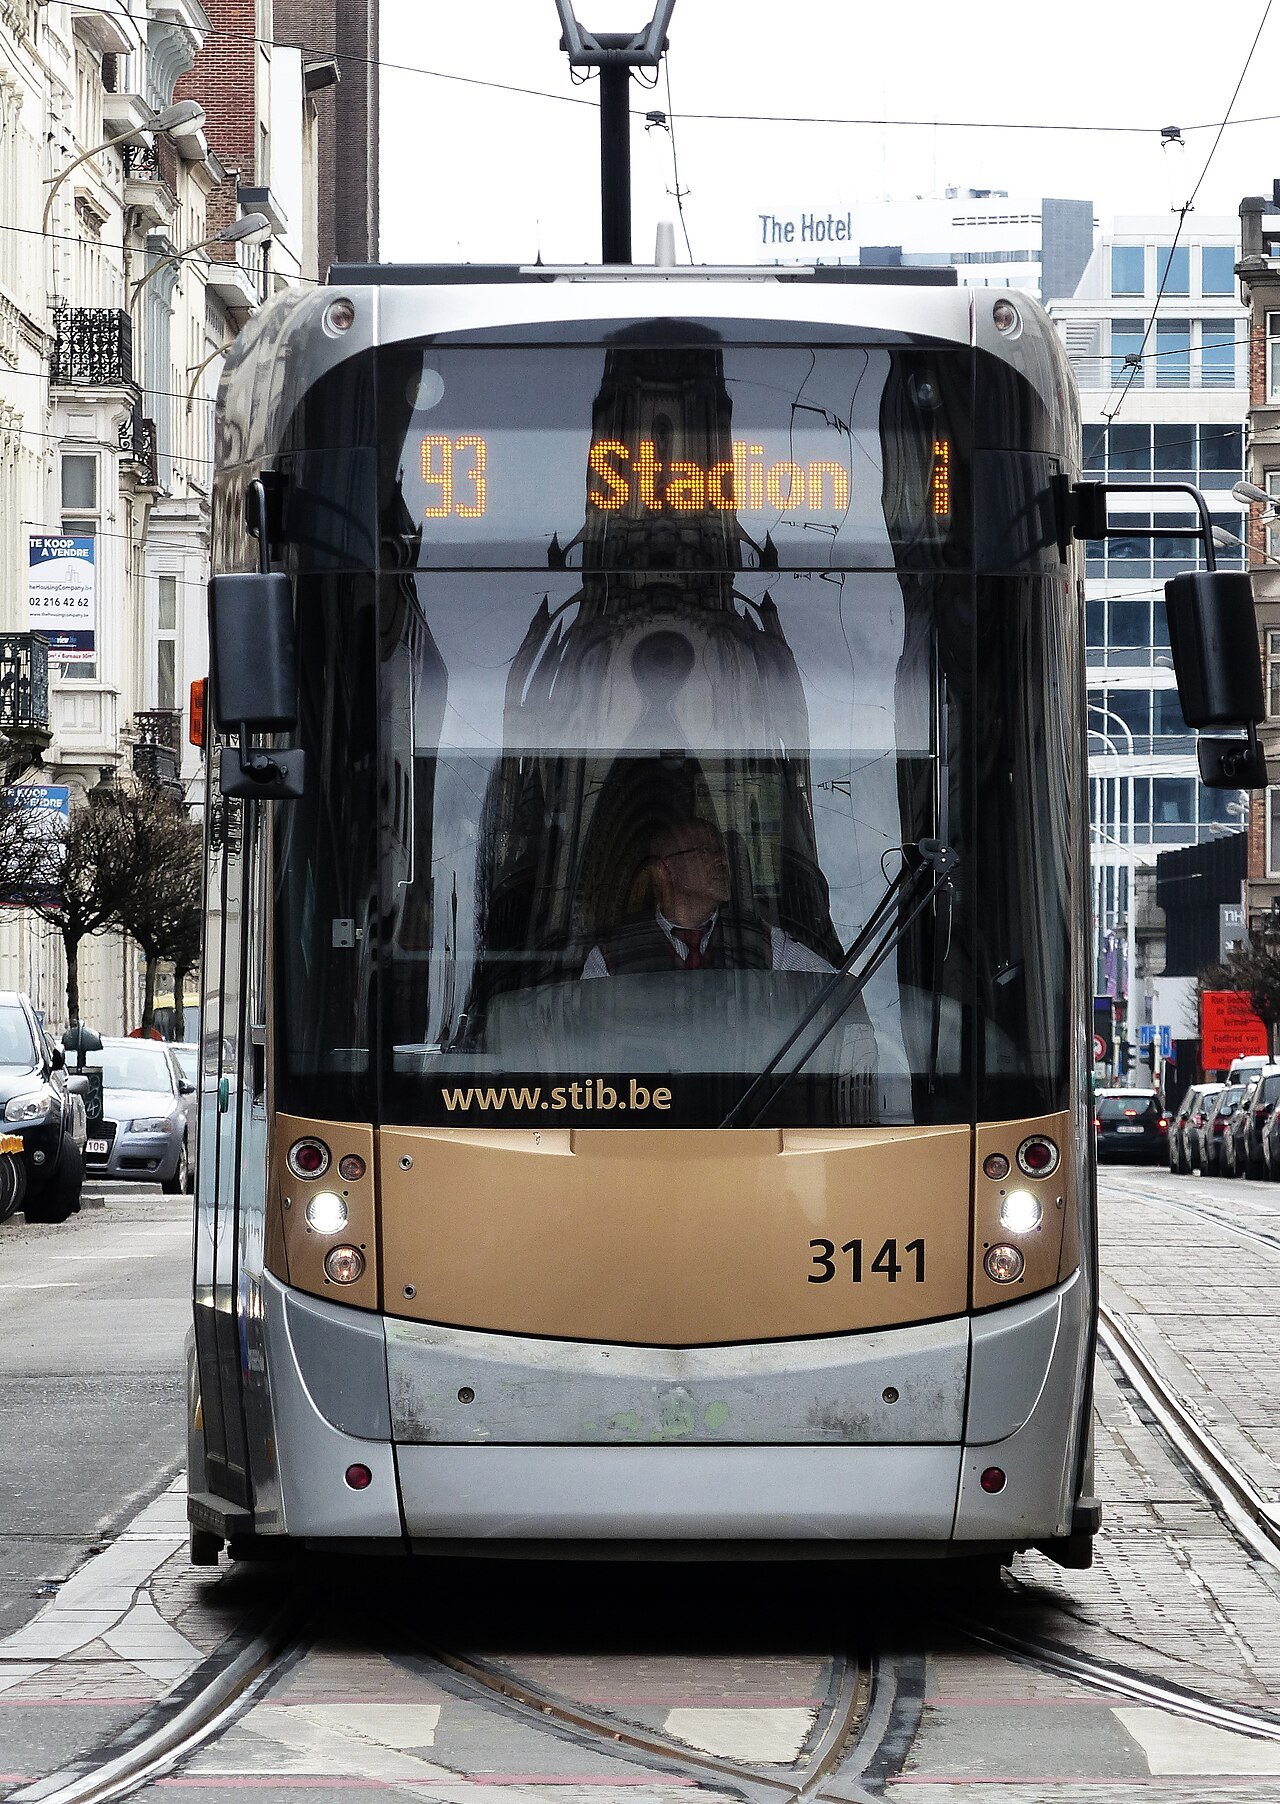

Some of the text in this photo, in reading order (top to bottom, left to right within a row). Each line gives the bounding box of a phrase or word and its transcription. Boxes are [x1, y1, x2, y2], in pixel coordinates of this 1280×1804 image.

[758, 212, 852, 244] The Hotel
[420, 435, 849, 519] 93 Stadion
[29, 538, 74, 549] TE KOOP
[41, 547, 90, 557] A VENDRE
[29, 597, 89, 607] 02 216 42 62
[441, 1078, 673, 1111] www.stib.be
[88, 1141, 105, 1152] 106
[807, 1238, 926, 1284] 3141
